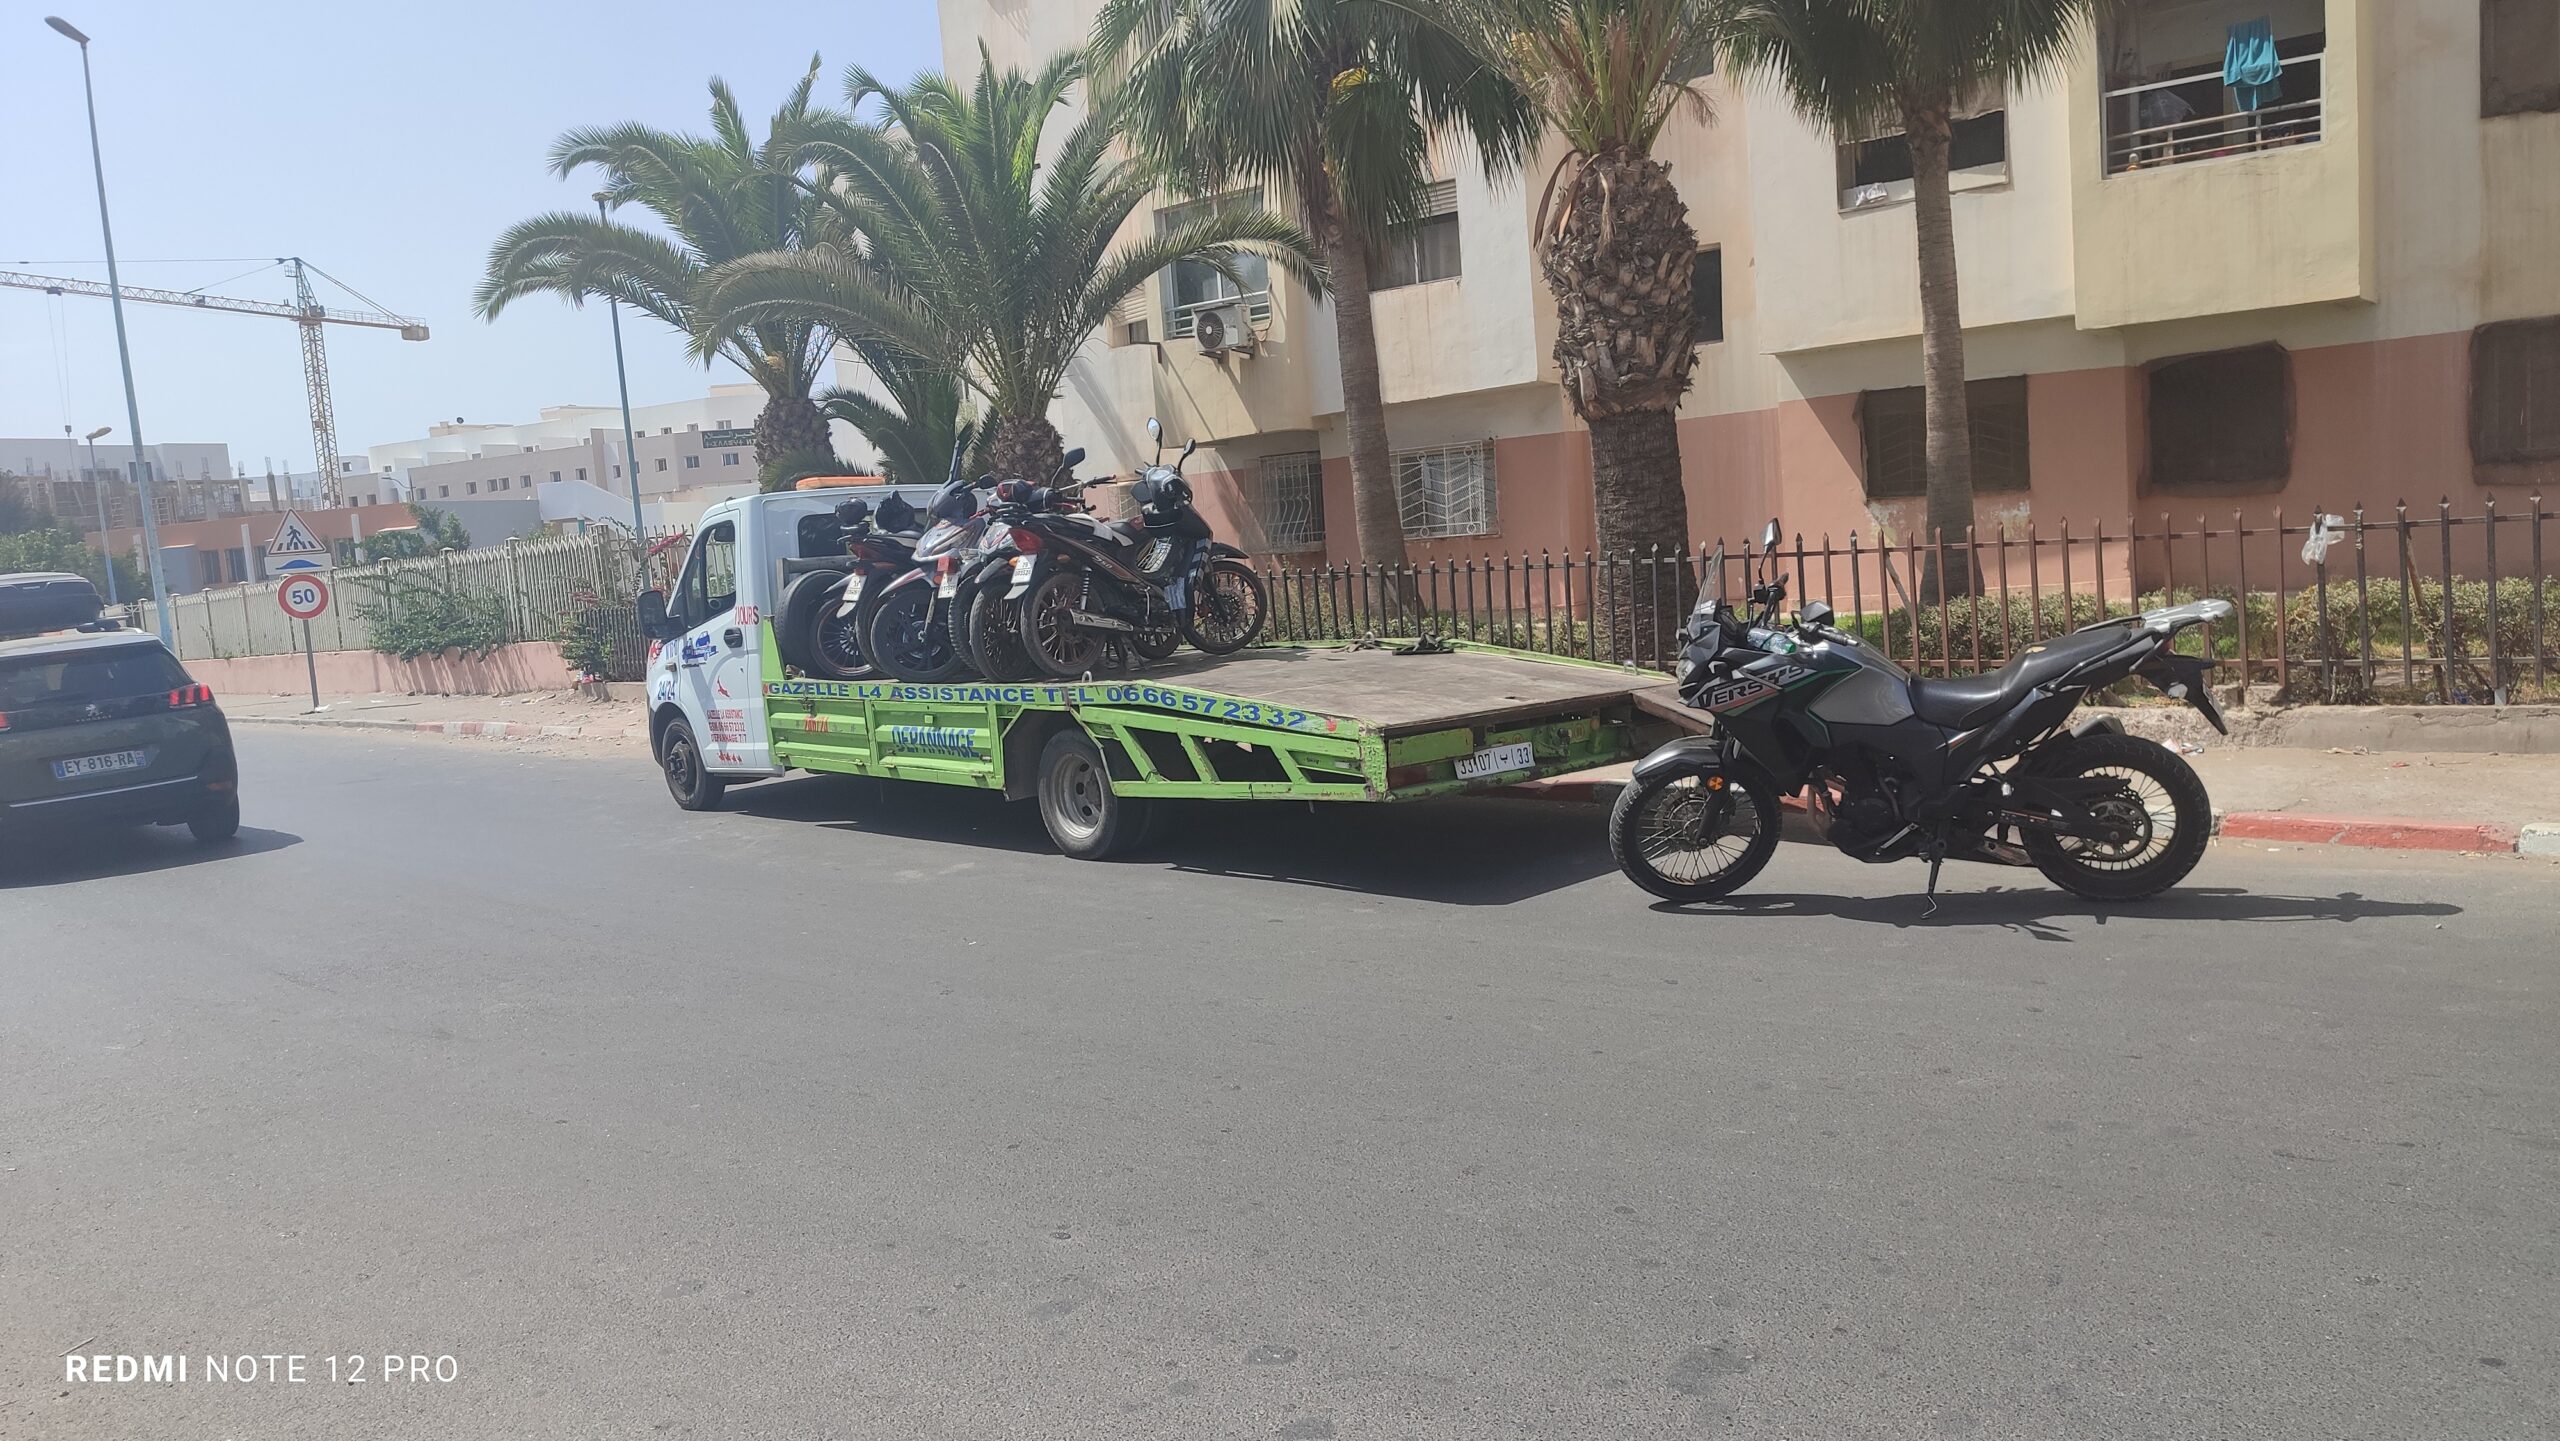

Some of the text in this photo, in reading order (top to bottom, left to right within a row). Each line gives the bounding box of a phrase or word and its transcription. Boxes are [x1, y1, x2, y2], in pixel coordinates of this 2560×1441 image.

[292, 588, 315, 604] 50
[657, 680, 676, 701] 24/24
[769, 683, 1307, 728] GAZELLE L4 ASSISTANCE TEL 0666 57 23 32
[892, 726, 980, 758] DEPANNAGE
[64, 752, 136, 774] EY-816-RA
[1517, 747, 1530, 765] 33
